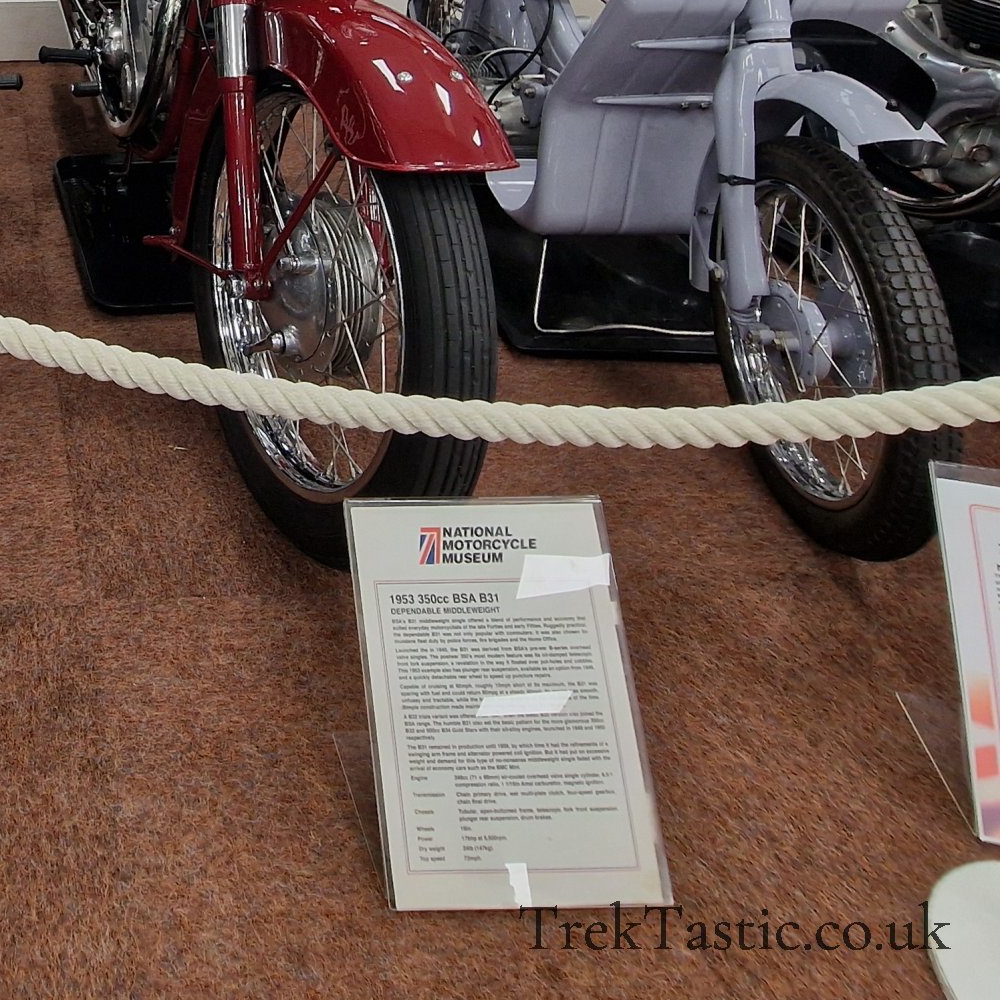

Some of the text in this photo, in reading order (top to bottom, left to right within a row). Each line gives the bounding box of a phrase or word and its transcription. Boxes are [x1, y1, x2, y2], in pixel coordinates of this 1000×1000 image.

[442, 526, 513, 538] NATIONAL
[442, 538, 537, 550] MOTORCYCLE
[442, 552, 504, 564] MUSEUM
[390, 593, 499, 605] 1953 350cc BSA B31
[390, 606, 500, 615] DEPENDABLE MIDDLEWEIGHT
